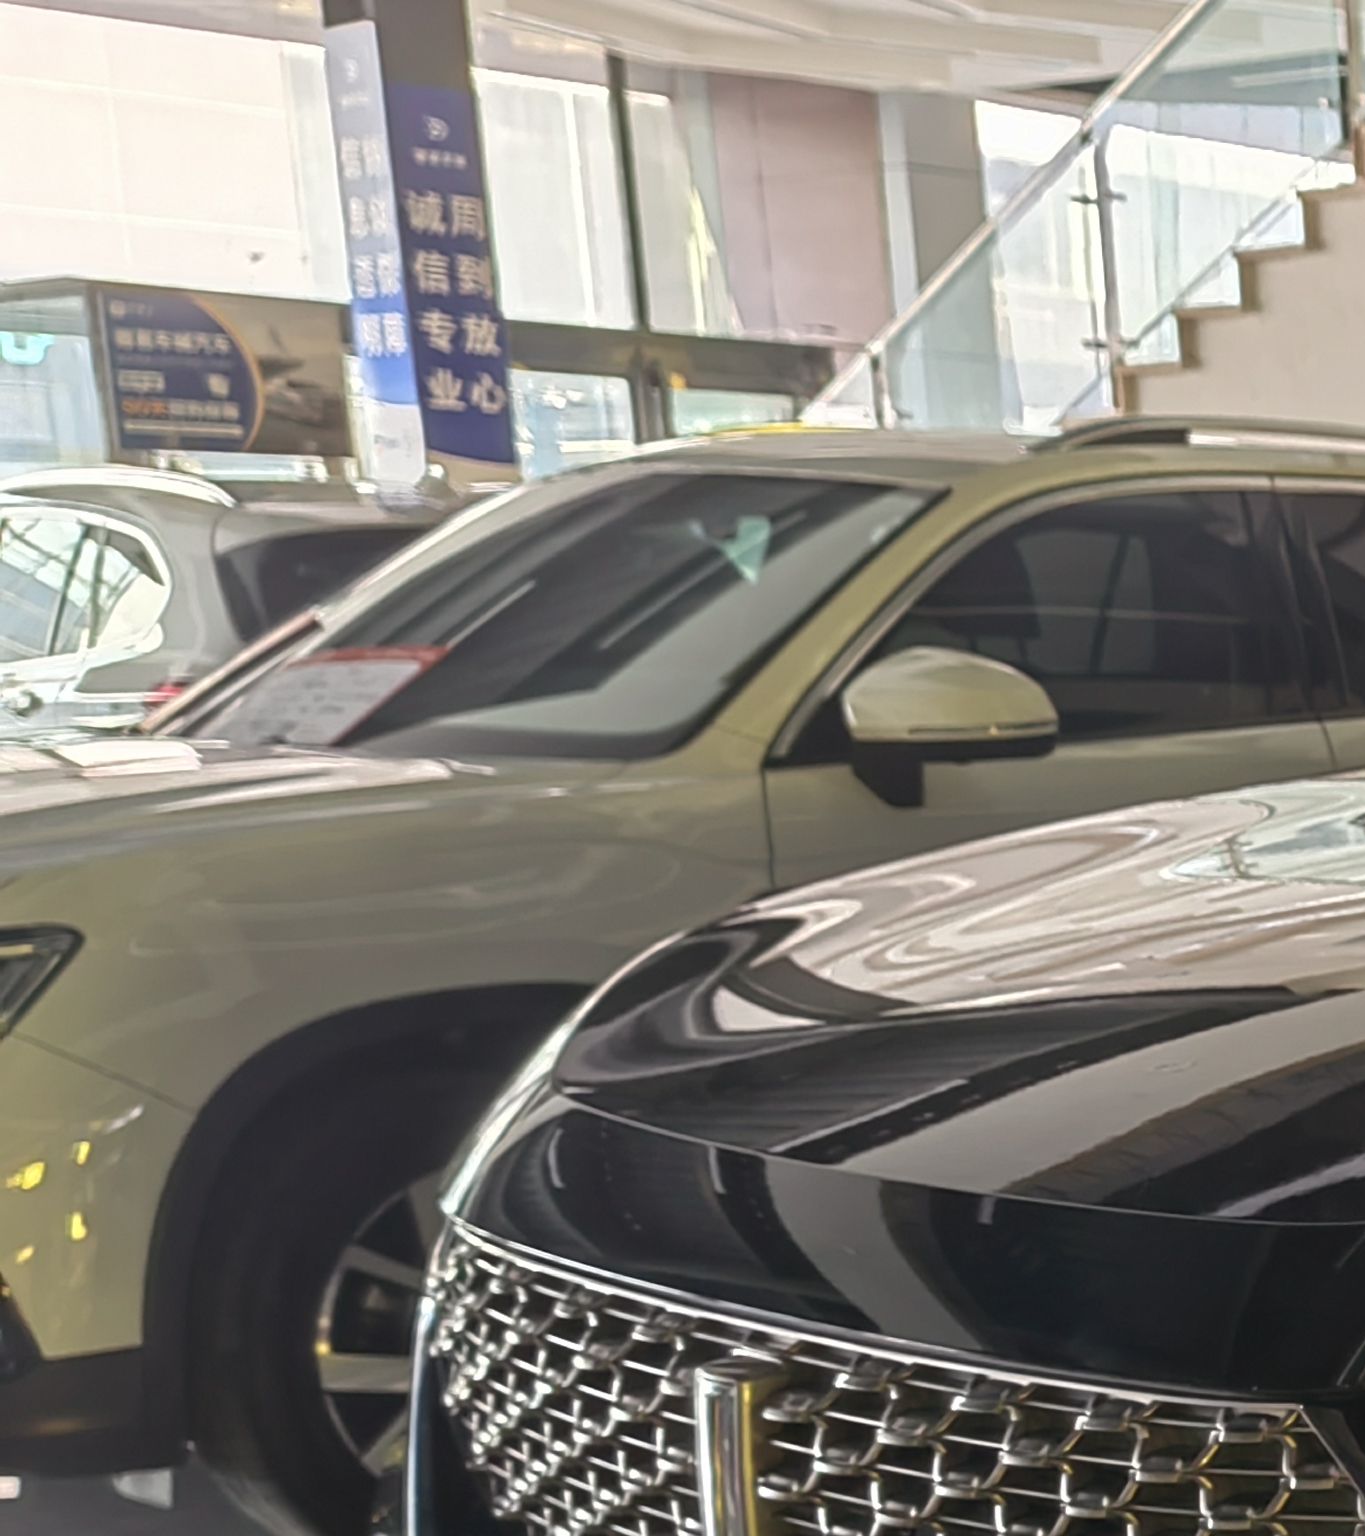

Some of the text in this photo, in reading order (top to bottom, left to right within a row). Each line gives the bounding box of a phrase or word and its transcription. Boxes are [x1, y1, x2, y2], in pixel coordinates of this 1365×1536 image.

[404, 190, 467, 414] 诚信专业
[451, 192, 506, 416] 周到放心
